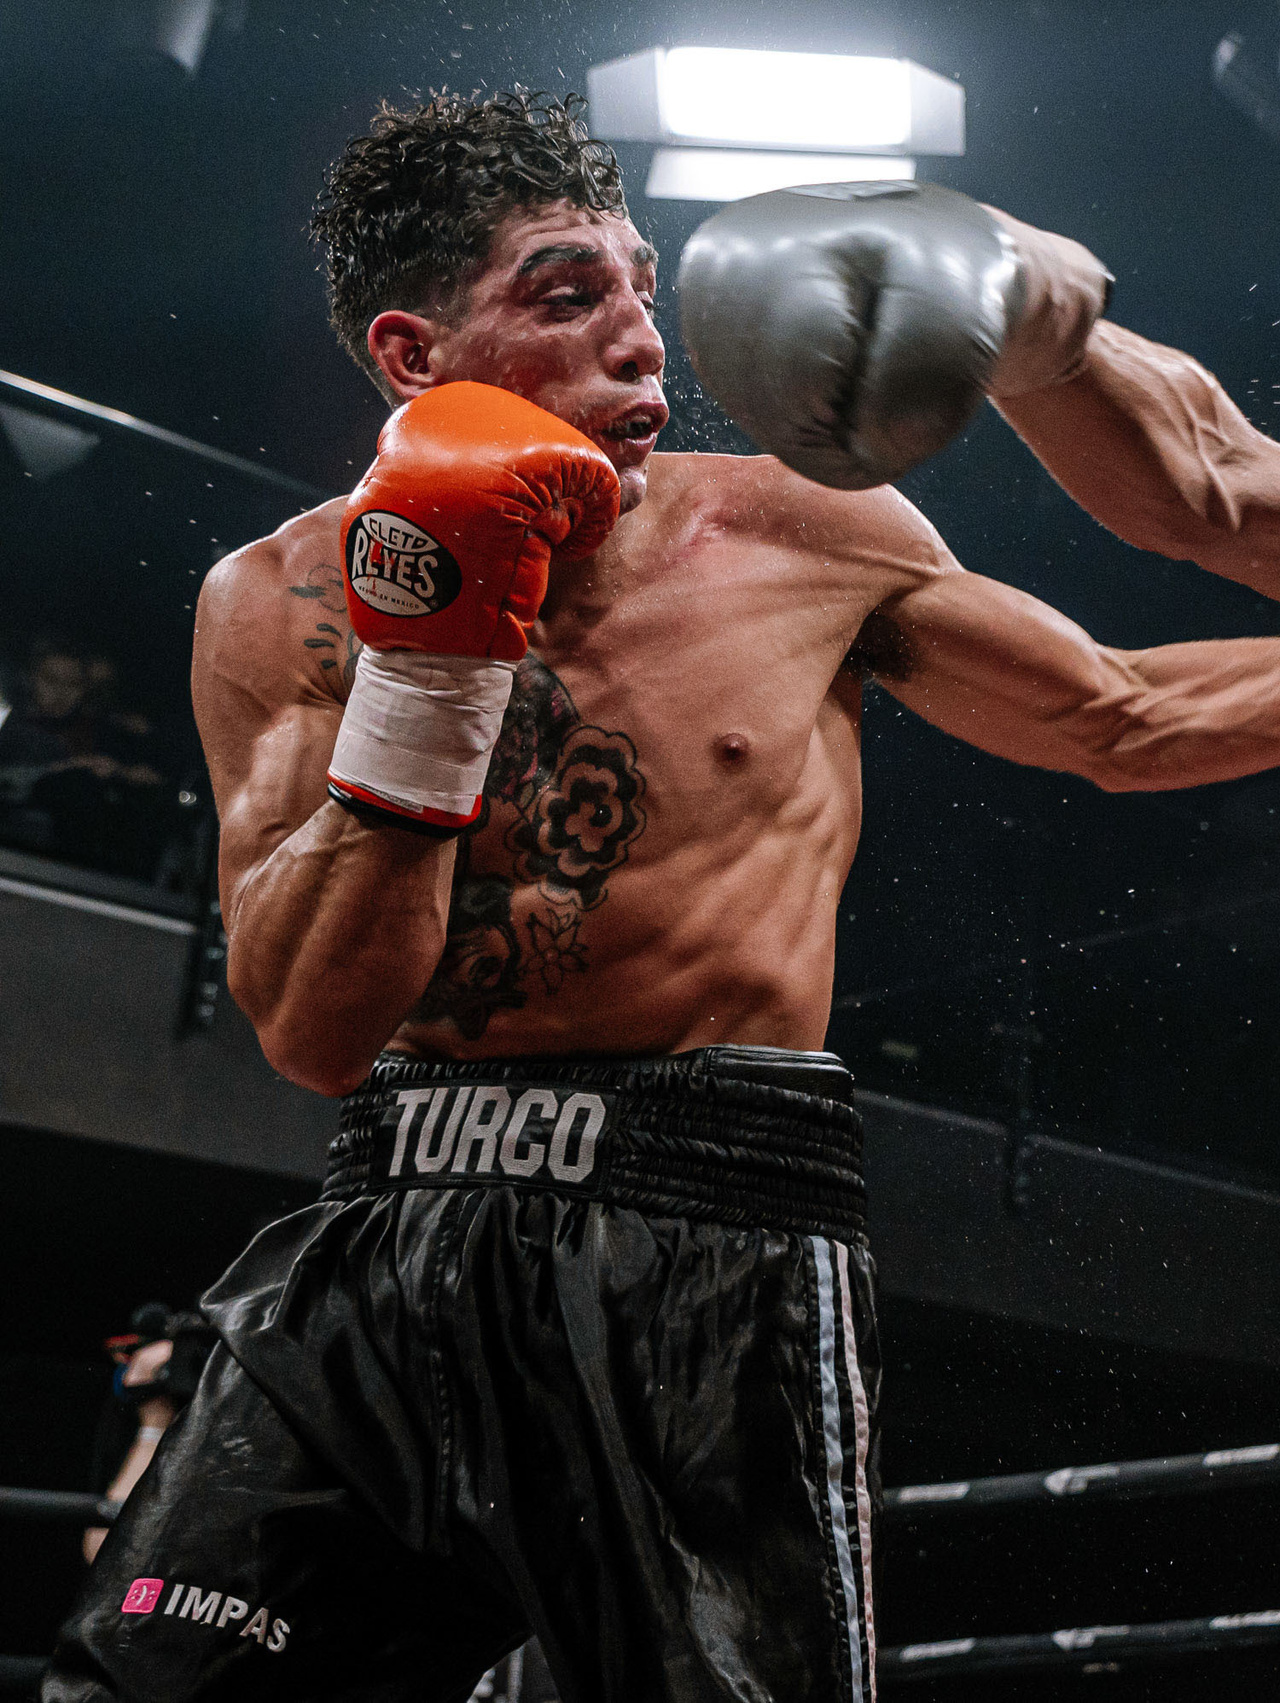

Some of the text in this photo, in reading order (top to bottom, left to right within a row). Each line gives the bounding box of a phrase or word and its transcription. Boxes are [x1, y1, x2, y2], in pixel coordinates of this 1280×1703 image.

[351, 528, 438, 598] REYES
[369, 517, 428, 550] CLETO
[388, 1086, 606, 1183] TURCO
[164, 1583, 291, 1653] IMPAS
